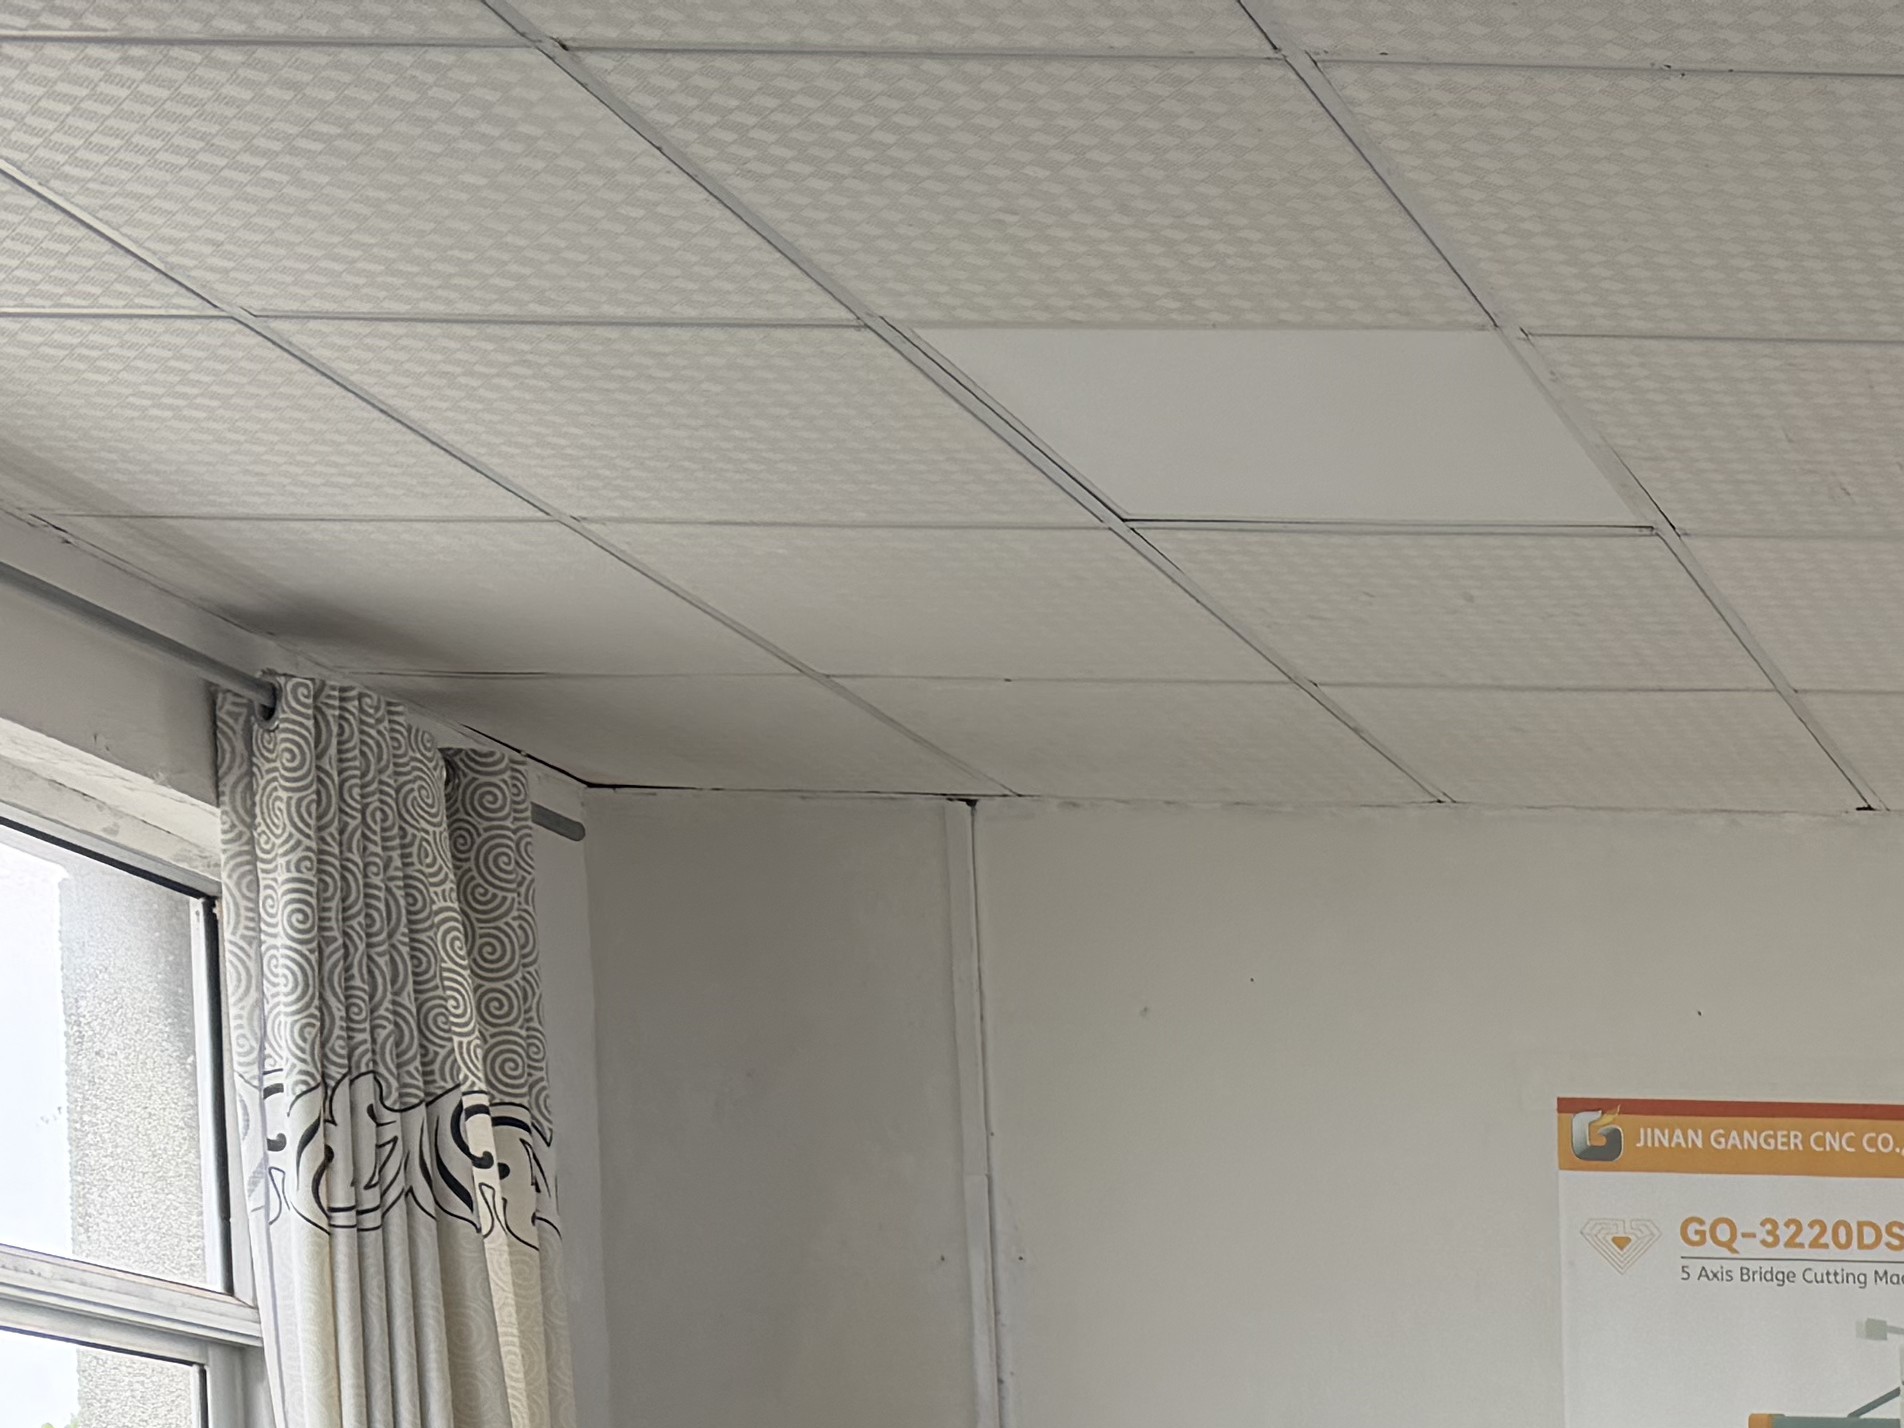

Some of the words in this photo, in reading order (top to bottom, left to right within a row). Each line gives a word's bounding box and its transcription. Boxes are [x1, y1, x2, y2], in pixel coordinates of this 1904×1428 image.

[1636, 1127, 1703, 1150] JINAN
[1710, 1128, 1803, 1152] GANGER
[1810, 1131, 1856, 1153] CNC
[1680, 1265, 1691, 1281] 5
[1697, 1265, 1734, 1283] Axis
[1739, 1266, 1796, 1288] Bridge
[1802, 1267, 1868, 1289] Cutting
